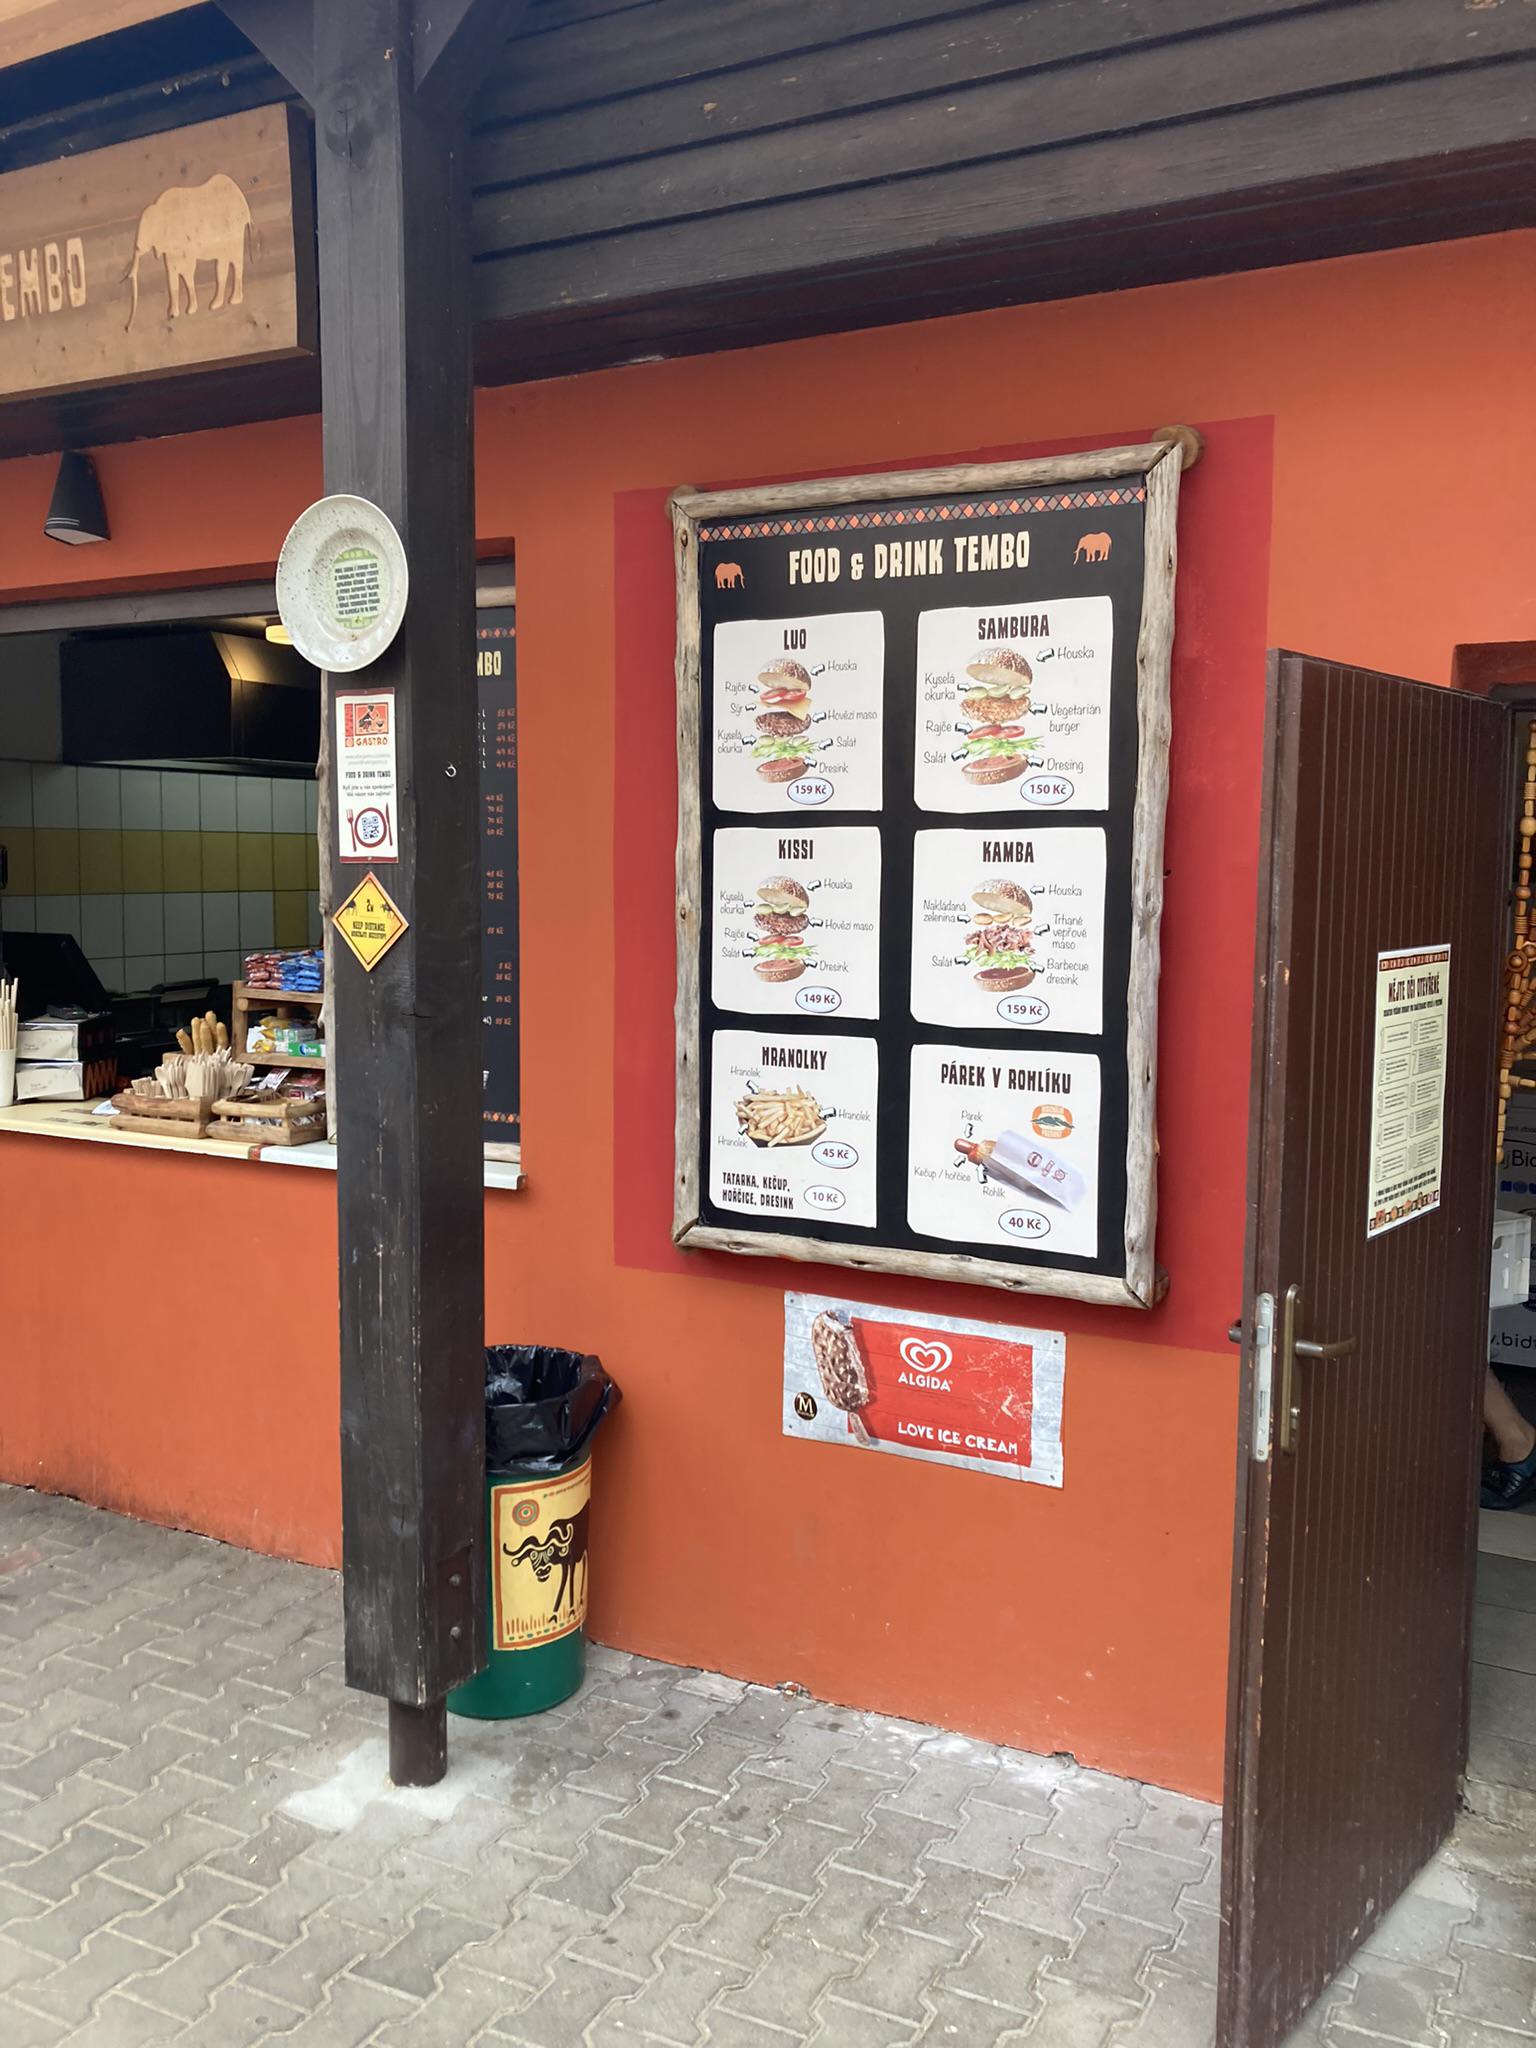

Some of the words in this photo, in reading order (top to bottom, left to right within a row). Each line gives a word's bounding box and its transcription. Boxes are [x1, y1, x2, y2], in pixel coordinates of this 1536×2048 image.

[790, 548, 840, 585] FOOD
[851, 553, 864, 580] &
[875, 539, 943, 579] DRINK
[954, 531, 1030, 574] TEMBO
[978, 614, 1049, 640] SAMBURA
[784, 629, 806, 650] LUO
[1057, 647, 1094, 660] Houska
[828, 660, 857, 671] Houska
[925, 673, 955, 686] Kyselá
[725, 681, 746, 694] Rajče
[925, 689, 955, 701] okurka
[730, 704, 742, 715] Sýr
[828, 709, 854, 720] Hovězí
[856, 712, 878, 720] maso
[1050, 704, 1101, 717] Vegetarián
[926, 720, 952, 734] Rajče
[1049, 721, 1080, 733] burger
[356, 737, 387, 746] GASTRO
[837, 737, 856, 747] Salát
[717, 742, 742, 754] okurka
[924, 752, 946, 764] Salát
[819, 763, 848, 774] Dresink
[1047, 759, 1084, 773] Dresing
[795, 785, 812, 795] 159
[815, 784, 827, 795] Kč
[1030, 784, 1050, 795] 150
[1053, 784, 1066, 795] Kč
[779, 839, 814, 860] KISSI
[983, 841, 1034, 863] KAMBA
[824, 879, 852, 890] Houska
[1049, 884, 1082, 896] Houska
[720, 904, 744, 915] okurka
[923, 900, 966, 913] Nakládaná
[923, 912, 956, 923] zelenina
[1053, 913, 1083, 925] Trhané
[825, 920, 851, 931] Hovězí
[853, 923, 873, 931] maso
[724, 928, 745, 940] Rajče
[1053, 926, 1087, 939] vepřové
[1052, 940, 1076, 950] maso
[722, 947, 740, 958] Salát
[820, 960, 848, 972] Dresink
[932, 956, 953, 968] Salát
[1047, 958, 1089, 972] Barbecue
[1046, 973, 1078, 985] dresink
[803, 994, 821, 1005] 149
[824, 994, 835, 1005] Kč
[1007, 1004, 1026, 1015] 159
[1029, 1004, 1043, 1016] Kč
[762, 1046, 827, 1071] HRANOLKY
[730, 1066, 761, 1078] Hranolek
[941, 1061, 985, 1088] PÁREK
[993, 1068, 1001, 1089] V
[1008, 1067, 1071, 1095] ROHLÍKU
[839, 1109, 871, 1121] Hranolek
[962, 1109, 983, 1121] Párek
[718, 1136, 747, 1148] Hranolek
[822, 1148, 835, 1159] 45
[837, 1149, 849, 1160] Kč
[914, 1166, 938, 1179] Kečup
[812, 1191, 824, 1202] 10
[826, 1192, 838, 1204] Kč
[983, 1185, 1006, 1198] Rohlík
[760, 1194, 794, 1210] DRESINK
[1009, 1216, 1023, 1229] 40
[1026, 1217, 1041, 1231] Kč
[898, 1372, 951, 1392] ALGIDA
[800, 1396, 813, 1413] M
[898, 1422, 933, 1440] LOVE
[938, 1429, 960, 1445] ICE
[965, 1435, 1017, 1455] CREAM
